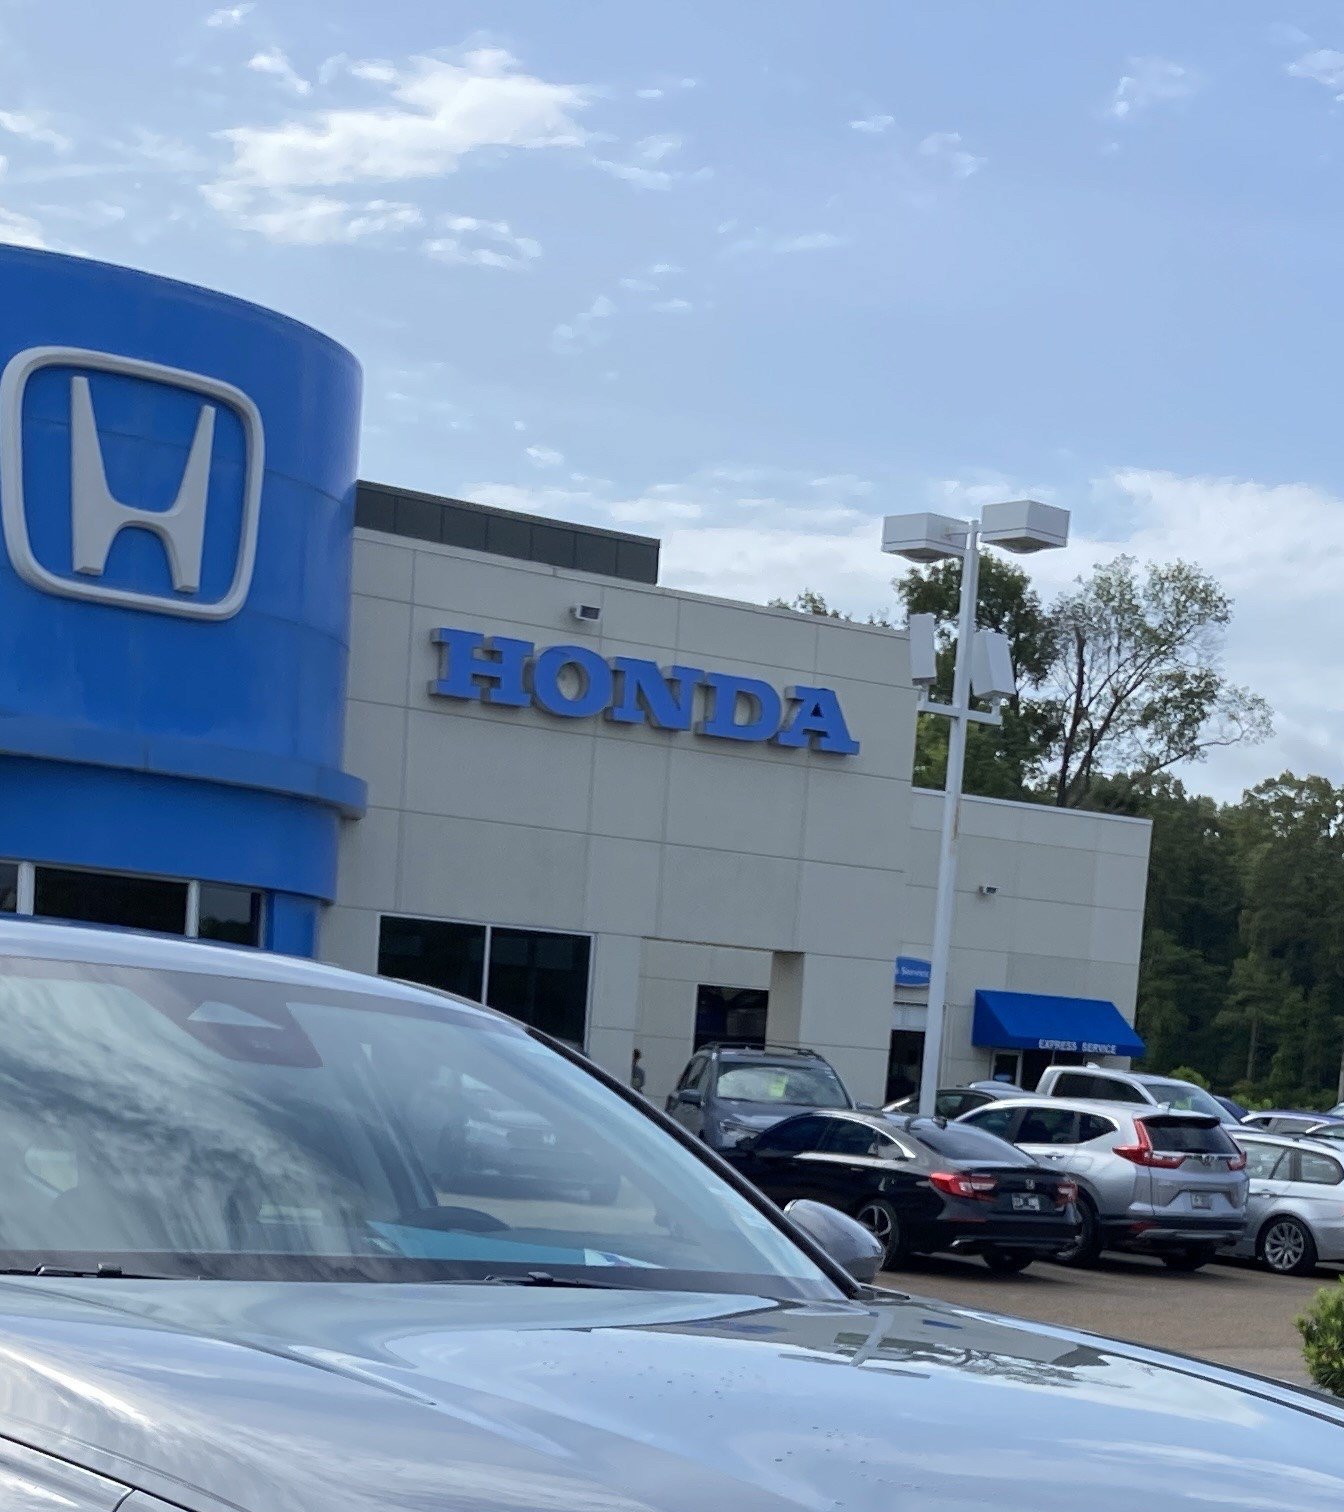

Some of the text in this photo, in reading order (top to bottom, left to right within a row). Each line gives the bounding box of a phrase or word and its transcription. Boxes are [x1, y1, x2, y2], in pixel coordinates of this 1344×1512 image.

[429, 627, 860, 756] HONDA
[1038, 1038, 1117, 1055] EXPRESS SERVICE
